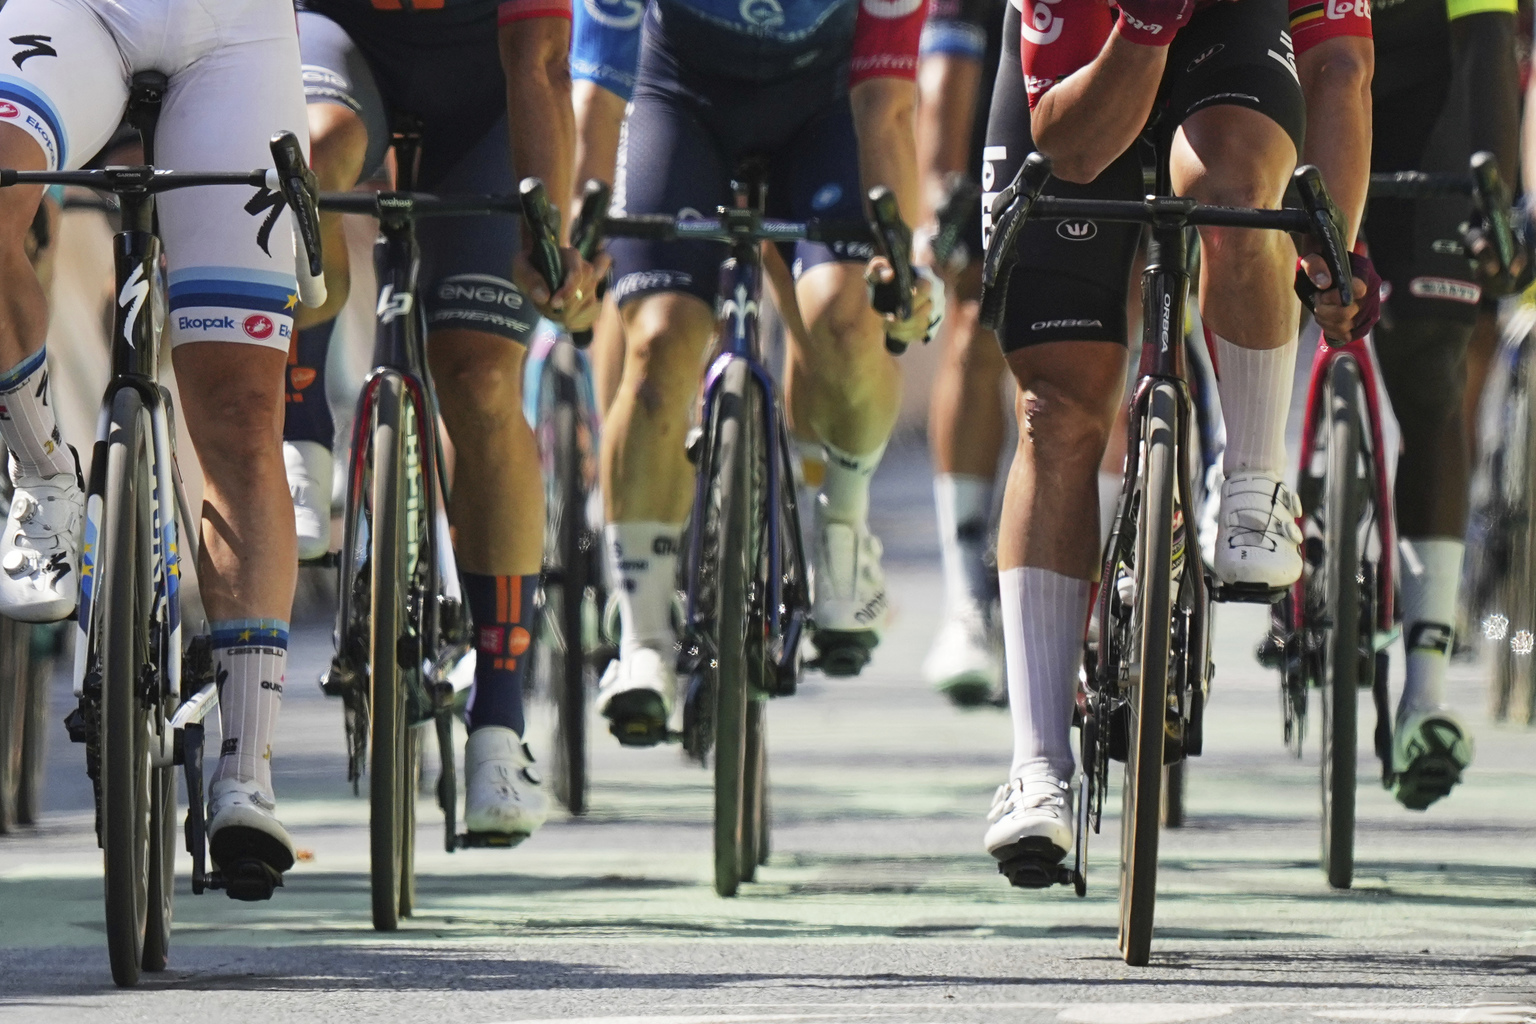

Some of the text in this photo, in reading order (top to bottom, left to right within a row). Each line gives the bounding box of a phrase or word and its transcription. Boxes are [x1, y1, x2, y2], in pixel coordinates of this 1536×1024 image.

[178, 316, 235, 330] Ekopak
[1031, 319, 1103, 330] ORBEA
[1161, 293, 1171, 353] ORBEA
[227, 647, 284, 657] CASTELLI
